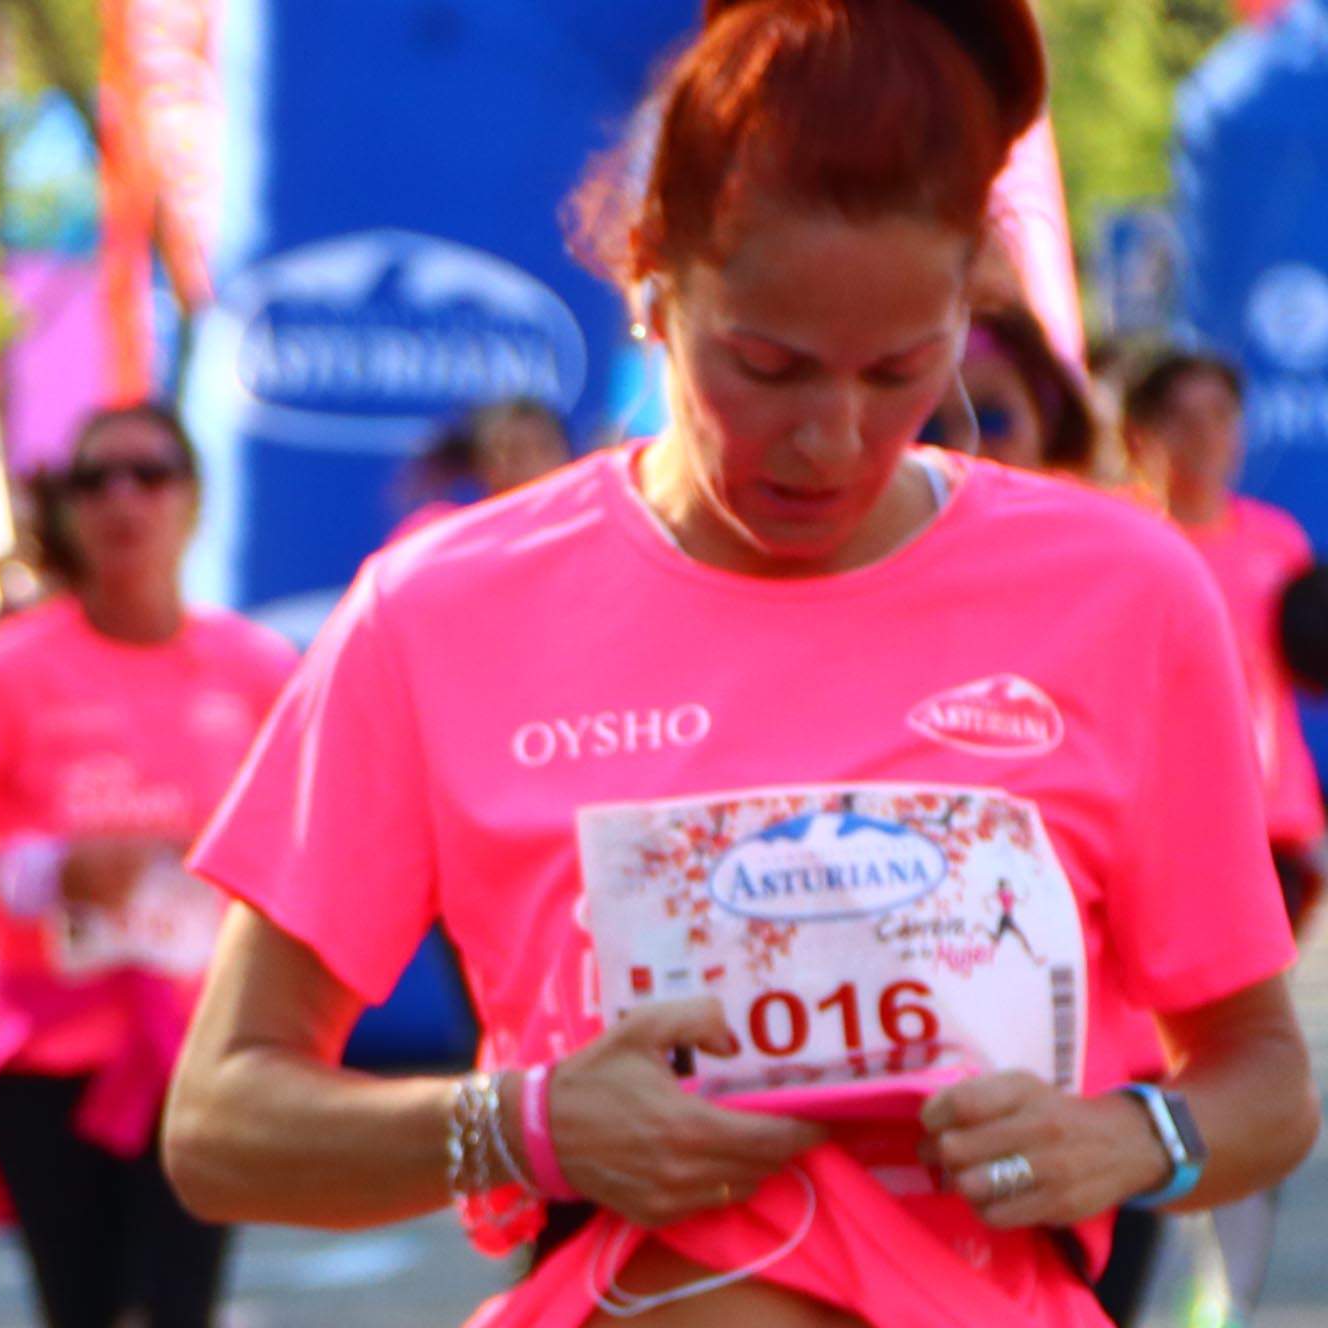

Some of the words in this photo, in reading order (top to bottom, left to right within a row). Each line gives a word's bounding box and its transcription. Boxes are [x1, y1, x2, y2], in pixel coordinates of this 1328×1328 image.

[512, 702, 711, 767] OYSHO
[730, 859, 929, 899] ASTURIANA
[748, 979, 941, 1058] 016
